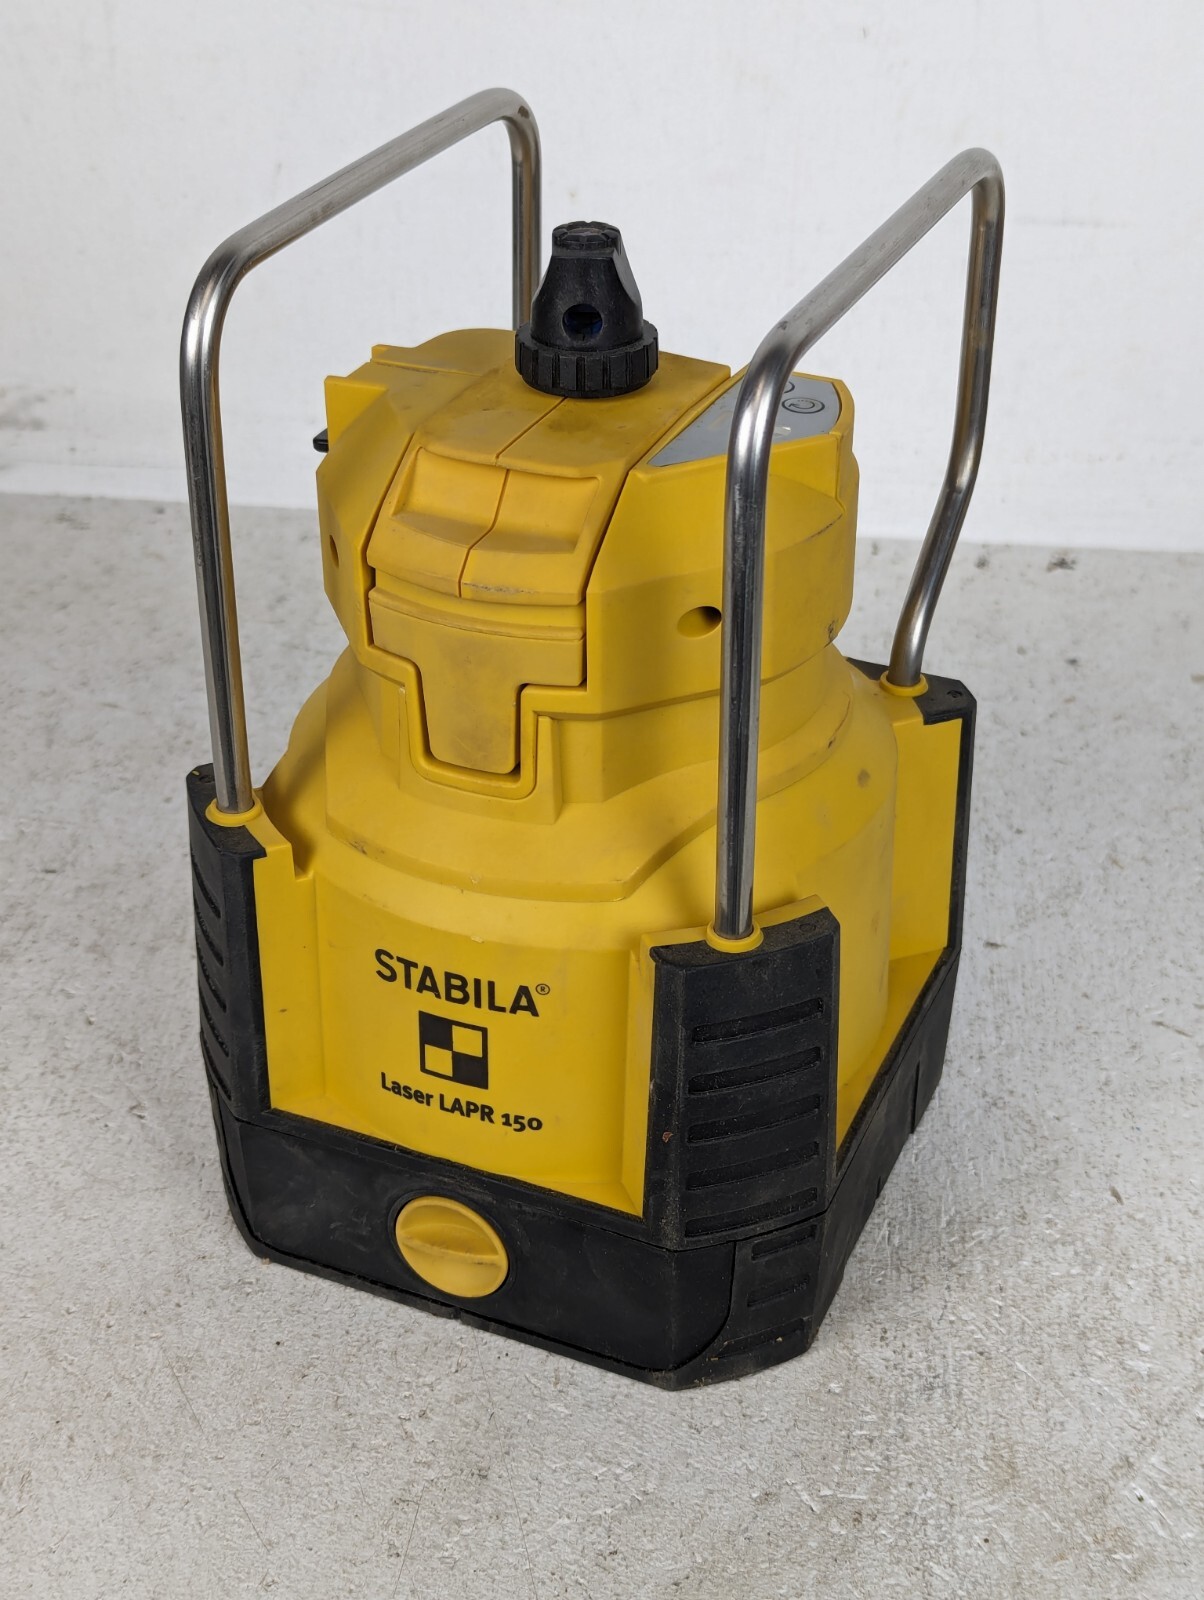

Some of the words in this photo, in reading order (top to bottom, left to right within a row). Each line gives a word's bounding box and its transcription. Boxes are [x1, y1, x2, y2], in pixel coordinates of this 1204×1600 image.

[380, 1071, 434, 1107] Laser
[439, 1093, 495, 1124] LAPR
[501, 1112, 543, 1133] 150
